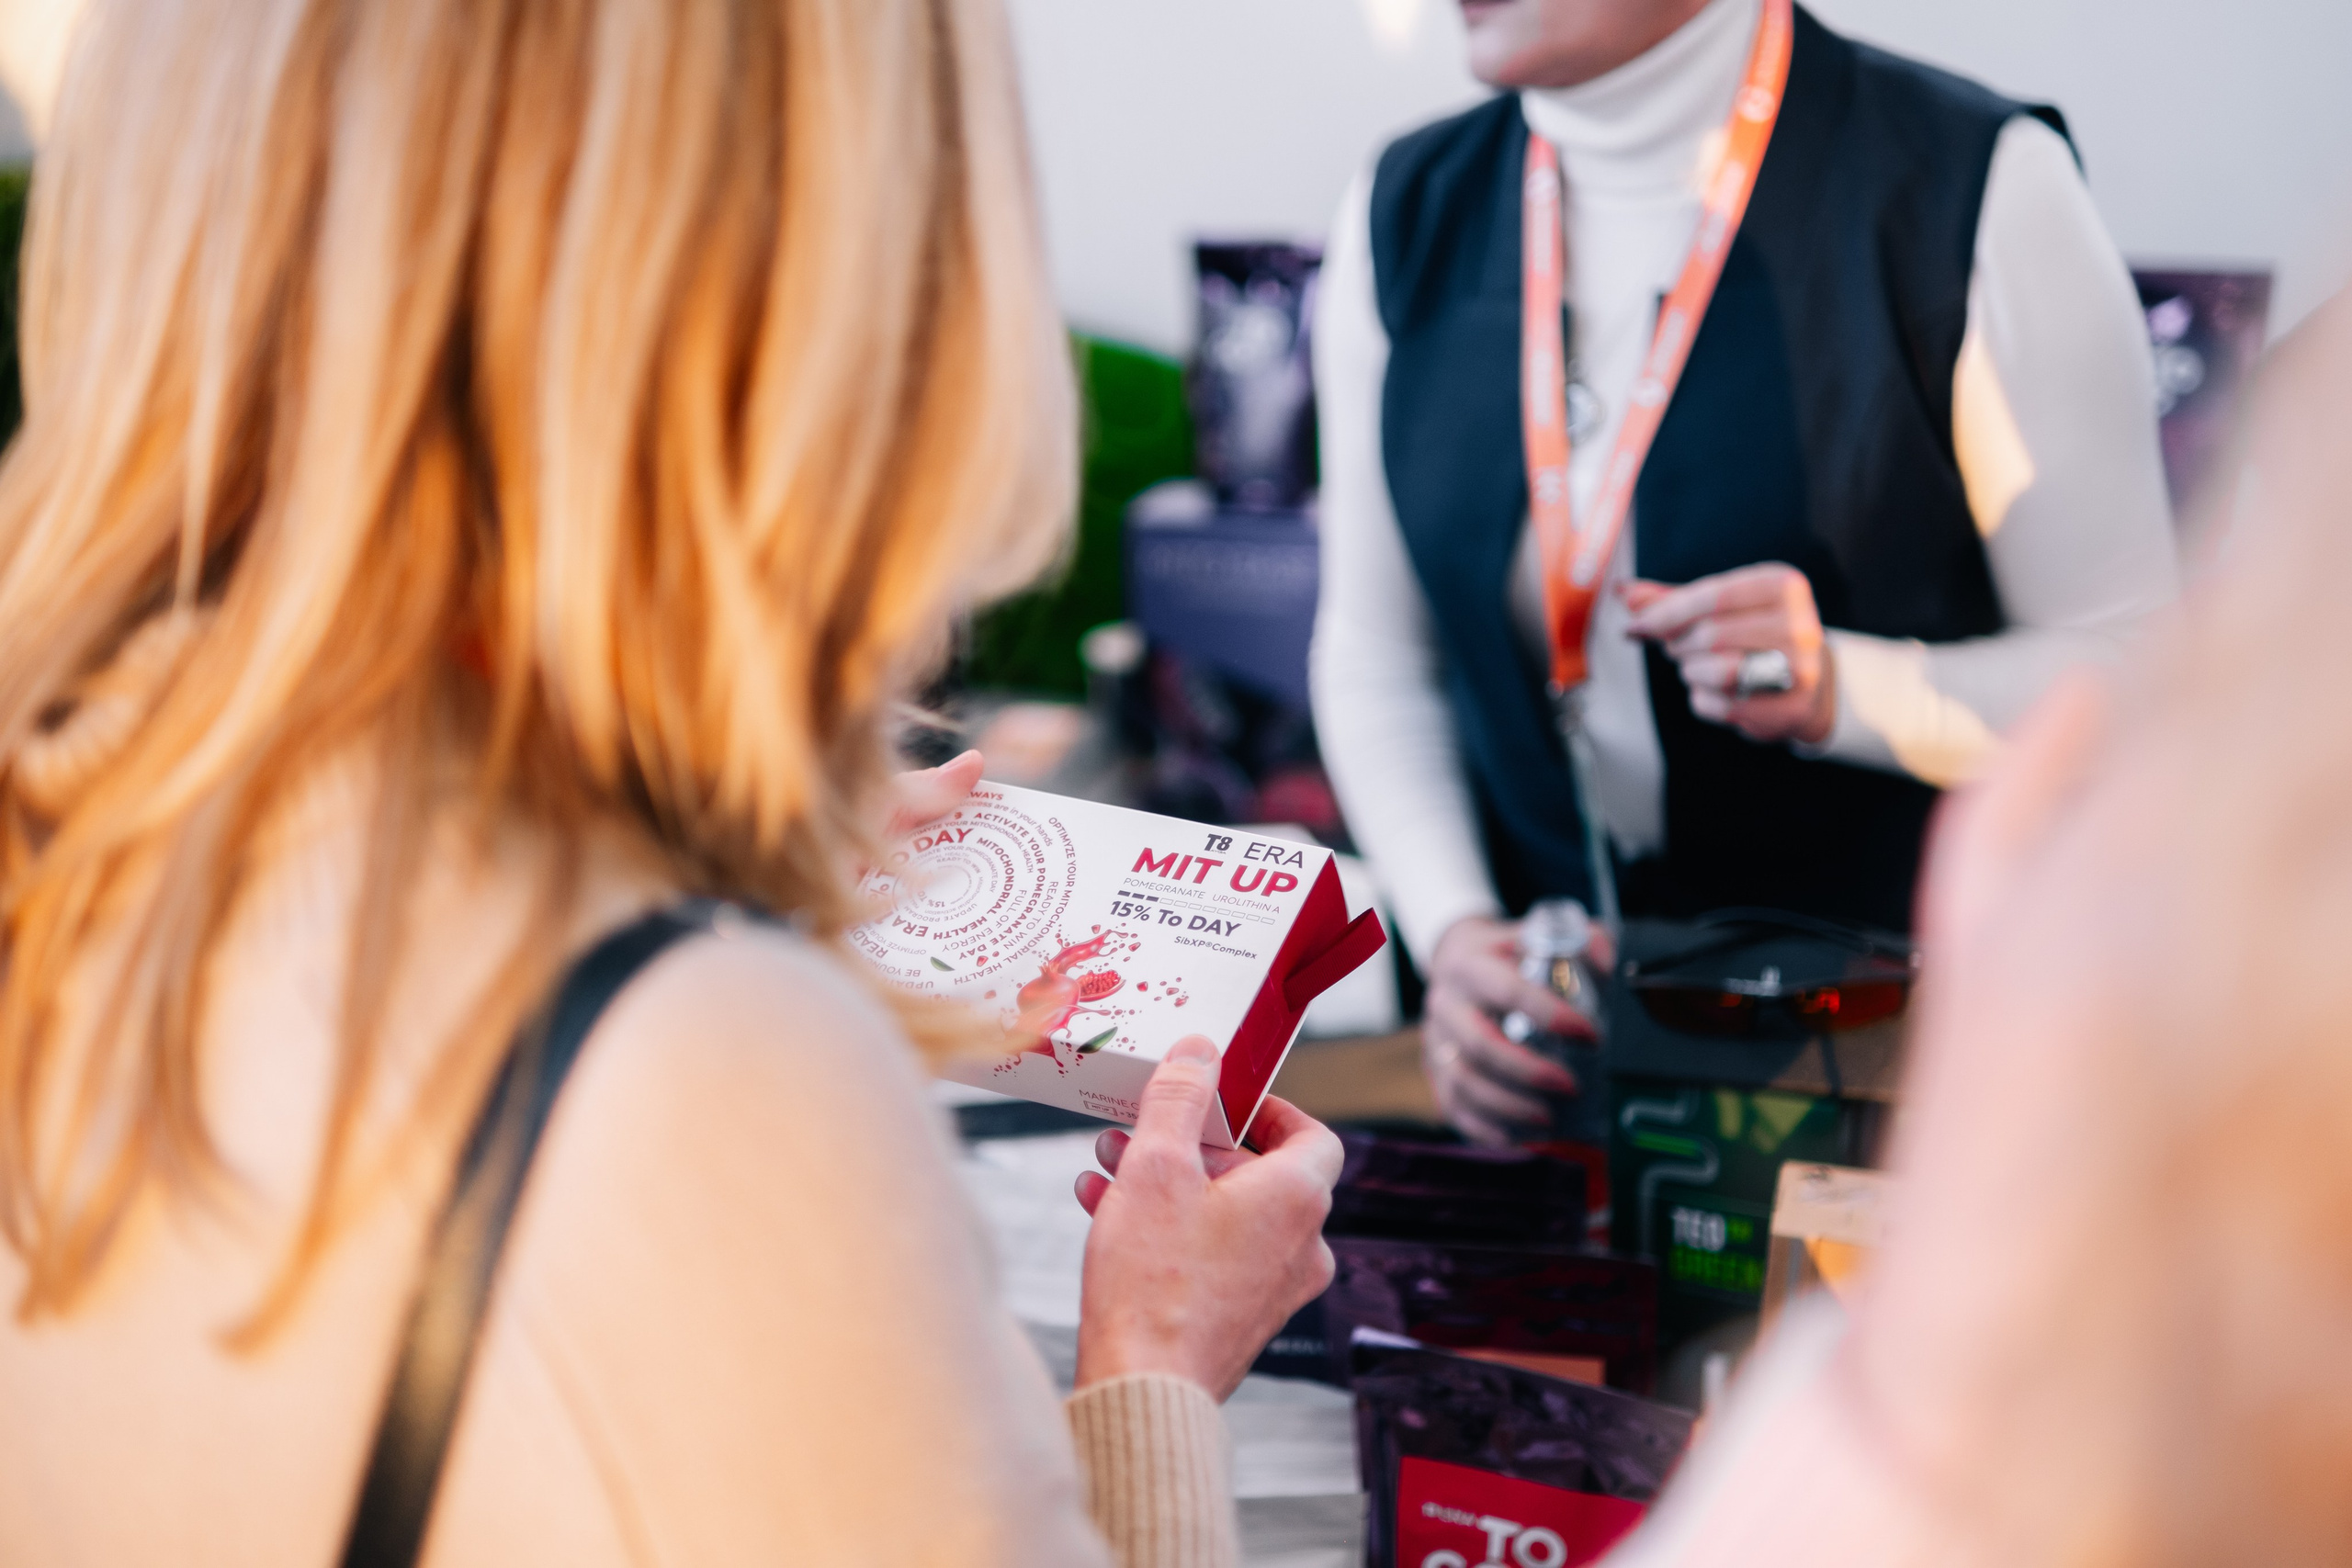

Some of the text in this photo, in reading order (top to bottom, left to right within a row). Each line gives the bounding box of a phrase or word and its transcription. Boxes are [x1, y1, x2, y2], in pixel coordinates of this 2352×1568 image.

[967, 791, 1003, 801] WAYS
[912, 828, 974, 854] DAY
[994, 804, 1009, 812] are
[1010, 807, 1019, 816] in
[1017, 813, 1037, 826] your
[1035, 824, 1053, 847] hands
[969, 821, 1024, 850] MITOCHONDRIAL
[1021, 849, 1034, 874] HEALTH
[1204, 833, 1304, 869] T8 ERA
[959, 812, 1046, 960] ACTIVATE YOUR POMEGRANATE DAY
[977, 837, 1015, 915] MITOCHONDRIAL
[989, 880, 998, 893] DAY
[1131, 847, 1298, 897] MIT UP
[903, 903, 978, 923] UPDATE PROGRAM
[954, 817, 1077, 986] OPTIMYZE YOUR MITOCHONDRIAL HEALTH
[1123, 877, 1281, 914] POMEGRANATE UROLITHIN A
[891, 915, 929, 938] ERA
[933, 915, 988, 940] HEALTH
[942, 889, 1027, 953] FULL OF ENERGY
[1003, 881, 1058, 950] READY TO WIN
[1110, 900, 1242, 937] 15% To DAY
[886, 942, 927, 955] OPTIMYZE
[905, 968, 922, 977] BE
[1079, 1089, 1129, 1109] MARINE
[1476, 1516, 1567, 1568] TO
